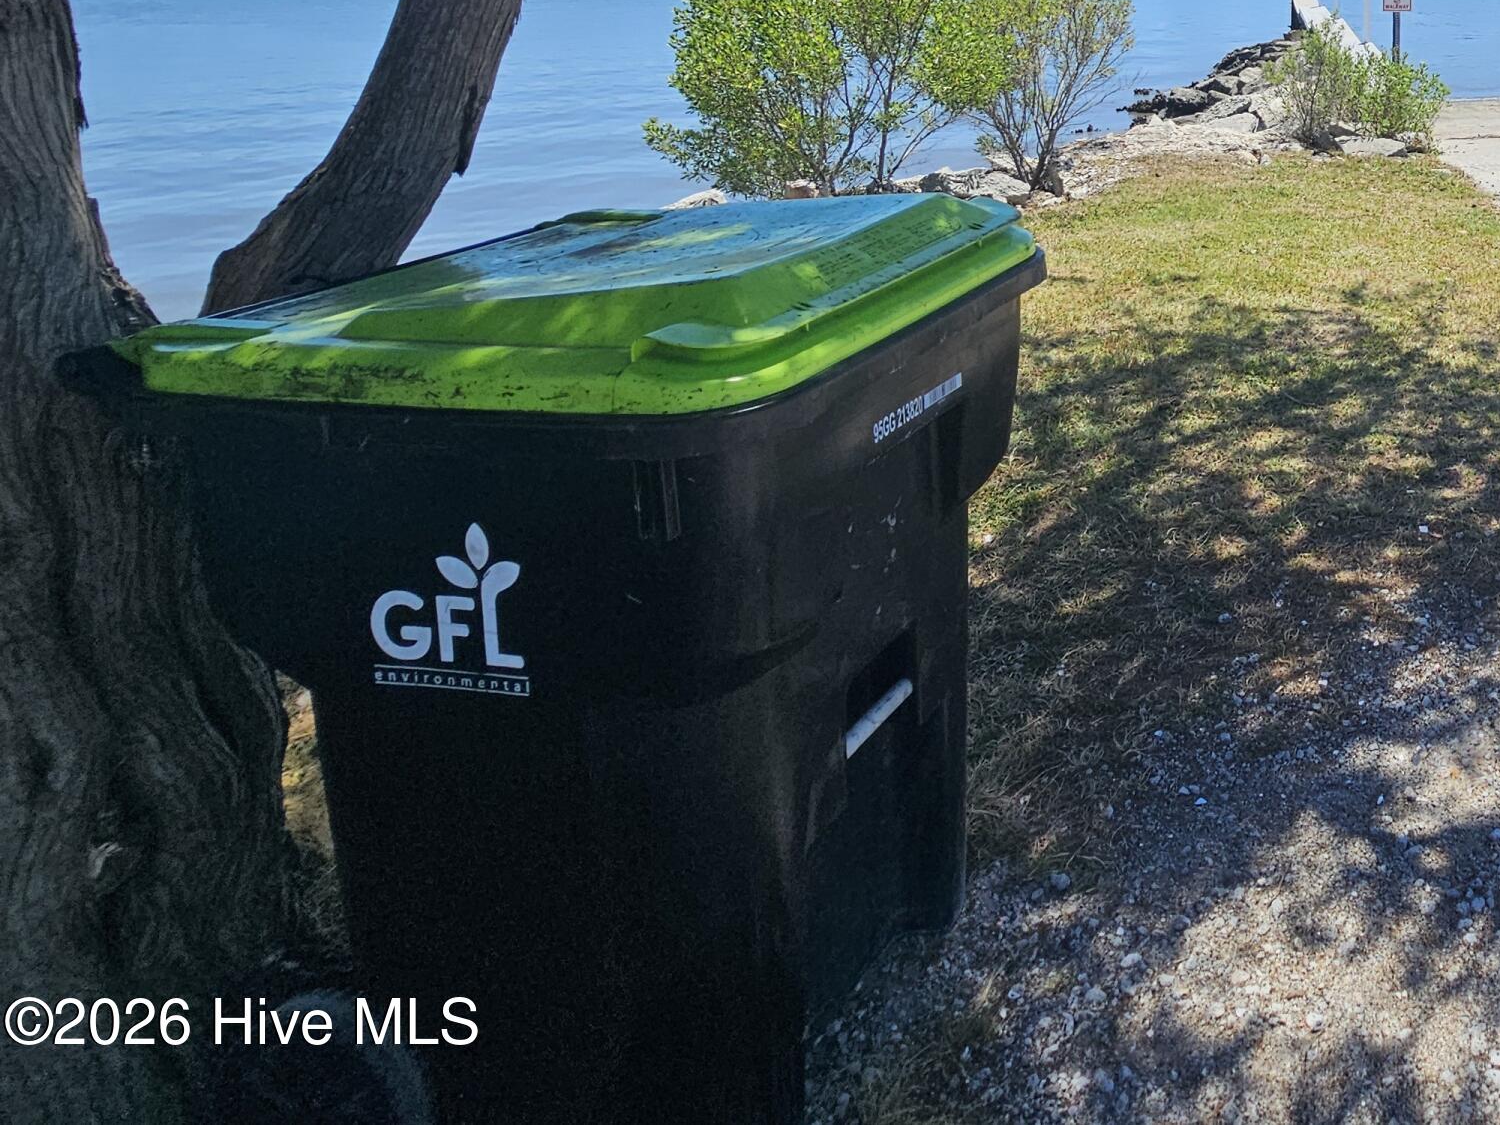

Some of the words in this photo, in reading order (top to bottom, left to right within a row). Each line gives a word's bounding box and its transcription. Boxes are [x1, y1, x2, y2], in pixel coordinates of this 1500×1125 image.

[873, 412, 896, 444] 95GG
[896, 395, 923, 428] 213820
[370, 560, 525, 669] GFL
[374, 671, 530, 693] environmental
